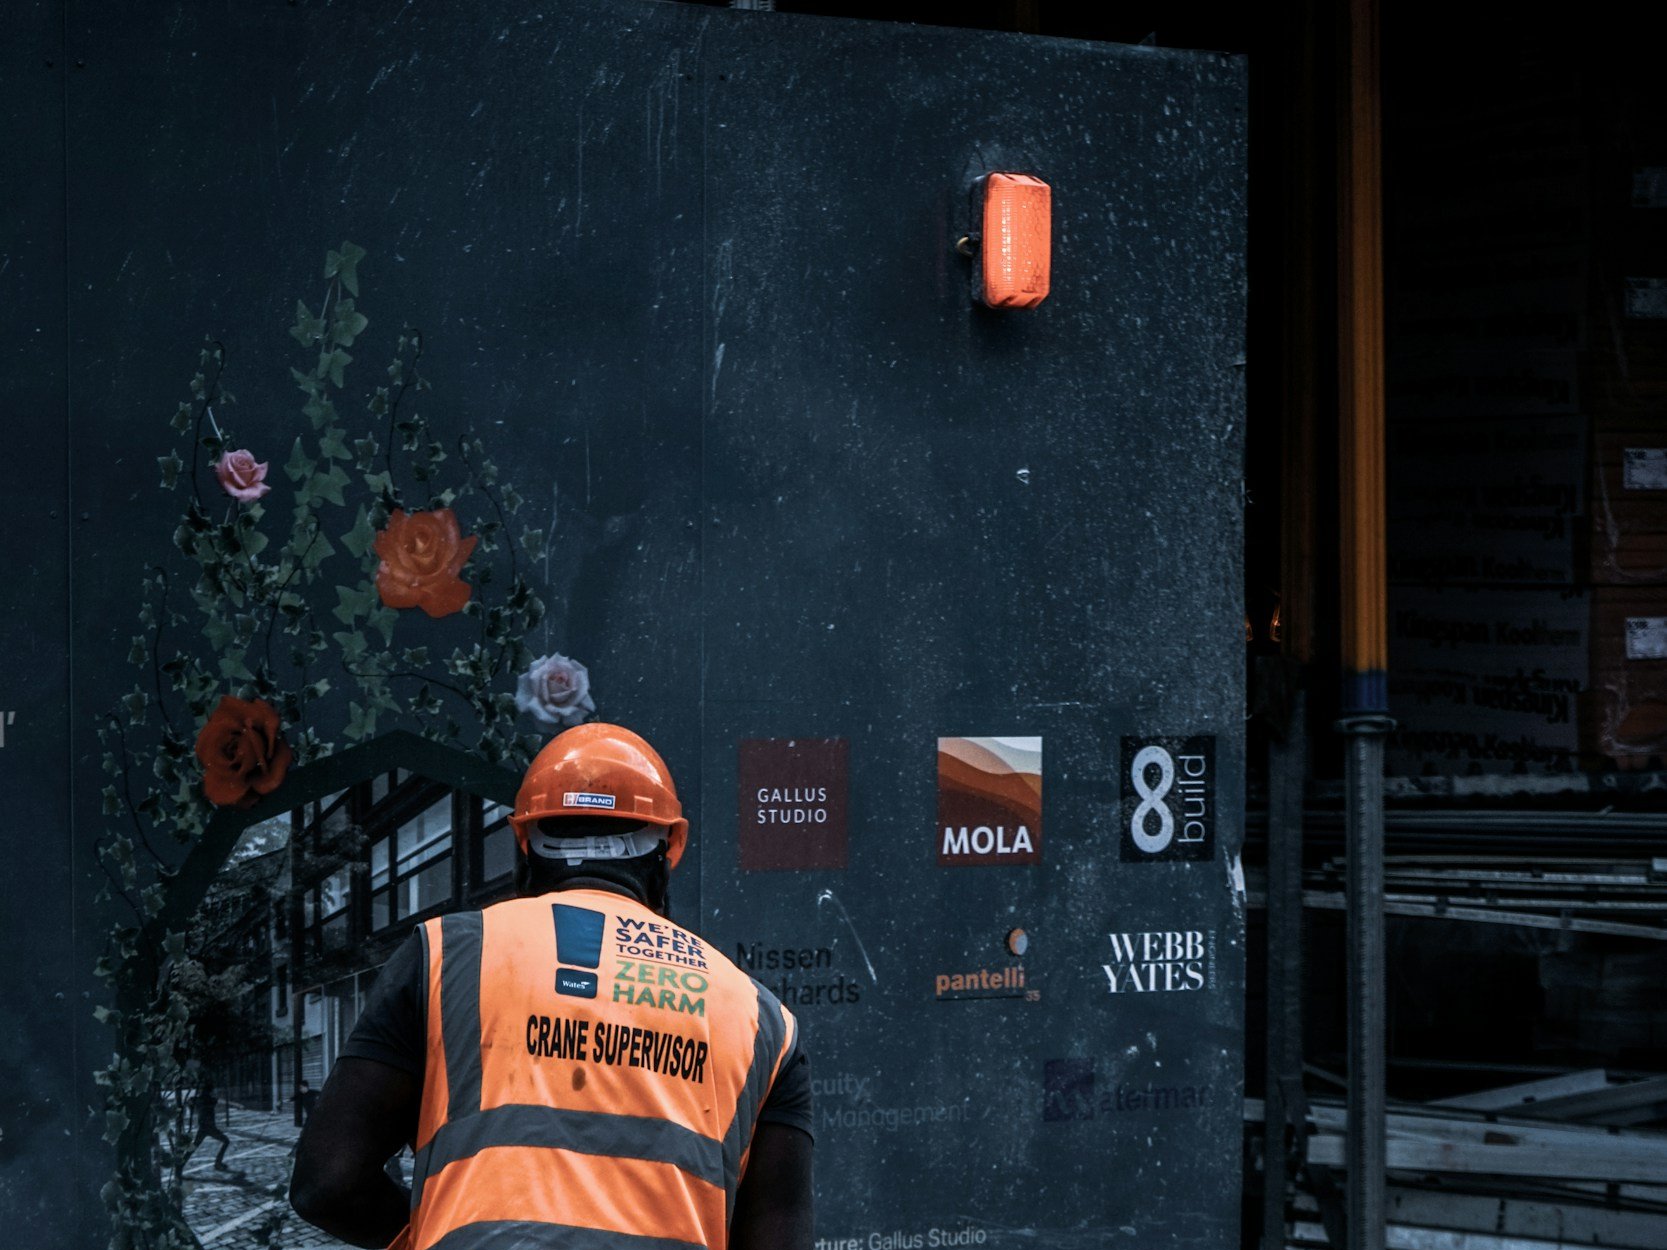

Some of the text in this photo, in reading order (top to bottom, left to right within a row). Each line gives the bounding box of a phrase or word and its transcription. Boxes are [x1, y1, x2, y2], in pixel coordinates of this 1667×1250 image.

[757, 787, 827, 803] GALLUS
[1130, 745, 1206, 853] 8 build
[757, 808, 827, 824] STUDIO
[942, 825, 1034, 855] MOLA
[616, 915, 704, 950] WE'RE
[616, 928, 706, 960] SAFER
[1107, 930, 1204, 962] WEBB
[616, 943, 709, 970] TOGETHER
[736, 941, 833, 971] Nissen
[614, 960, 709, 993] ZERO
[770, 976, 861, 1005] hards
[935, 966, 1025, 996] pantelli
[1100, 961, 1205, 994] YATES
[612, 982, 705, 1018] HARM
[526, 1014, 708, 1084] CRANE SUPERVISOR
[822, 1100, 970, 1132] Management
[927, 1226, 987, 1248] Studio
